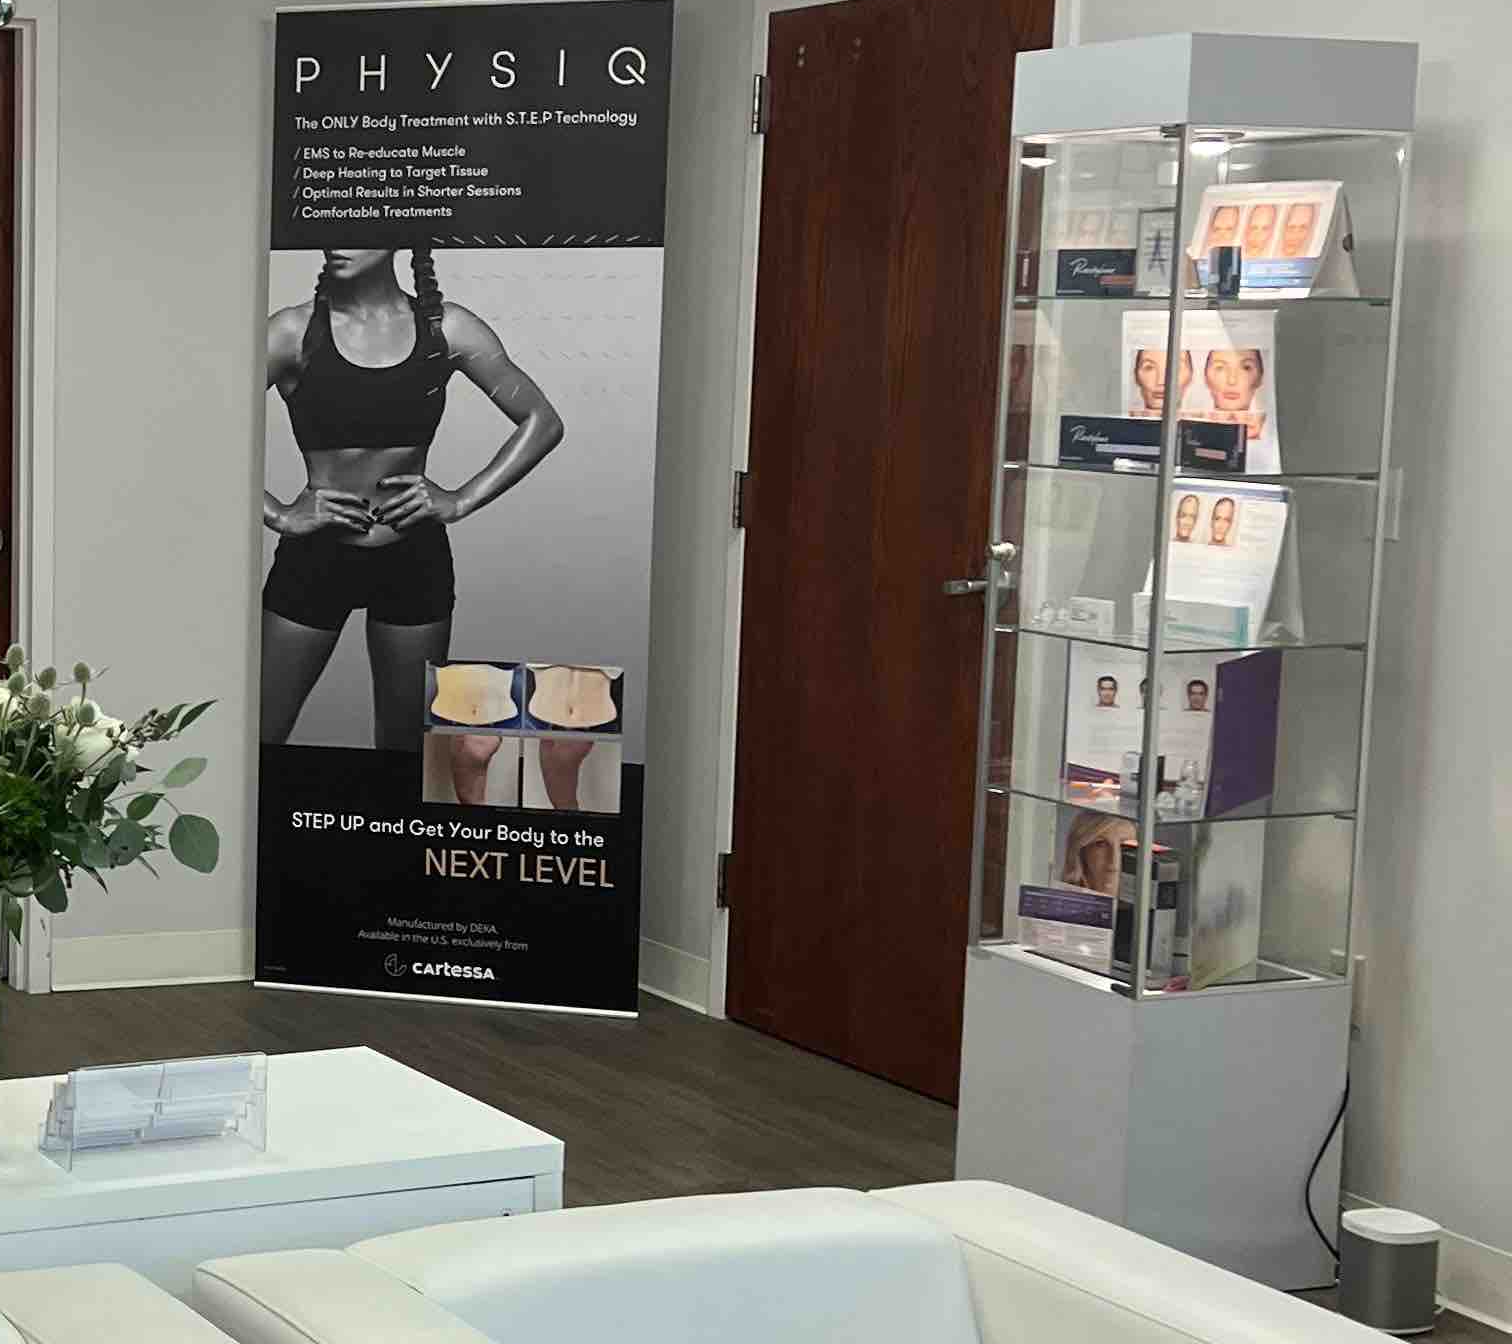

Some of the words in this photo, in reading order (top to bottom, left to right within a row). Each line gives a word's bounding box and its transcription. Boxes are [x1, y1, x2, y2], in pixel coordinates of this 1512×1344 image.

[295, 46, 647, 93] PHYSIQ
[295, 116, 319, 130] The
[321, 115, 359, 129] ONLY
[361, 114, 397, 132] Body
[400, 113, 469, 128] Treatment
[472, 112, 502, 126] with
[505, 111, 552, 125] S.T.E.P
[554, 109, 638, 127] Technology
[303, 147, 330, 160] EMS
[333, 147, 345, 159] to
[348, 146, 419, 159] Re-educate
[421, 144, 466, 158] Muscle
[302, 167, 335, 182] Deep
[338, 166, 387, 182] Heating
[390, 167, 403, 179] to
[405, 165, 446, 181] Target
[449, 164, 489, 177] Tissue
[302, 186, 353, 202] Optimal
[355, 186, 400, 199] Results
[402, 185, 415, 198] in
[416, 184, 463, 198] Shorter
[465, 183, 522, 197] Sessions
[301, 206, 380, 219] Comfortable
[382, 205, 453, 218] Treatments
[292, 811, 336, 830] STEP
[340, 814, 365, 831] UP
[369, 816, 404, 835] and
[409, 819, 444, 838] Get
[449, 821, 491, 841] Your
[497, 824, 545, 848] Body
[550, 828, 569, 846] to
[574, 829, 605, 848] the
[425, 848, 509, 881] NEXT
[519, 853, 615, 889] LEVEL
[387, 916, 455, 932] Manufactured
[456, 922, 468, 934] by
[412, 933, 429, 944] the
[504, 940, 529, 952] from
